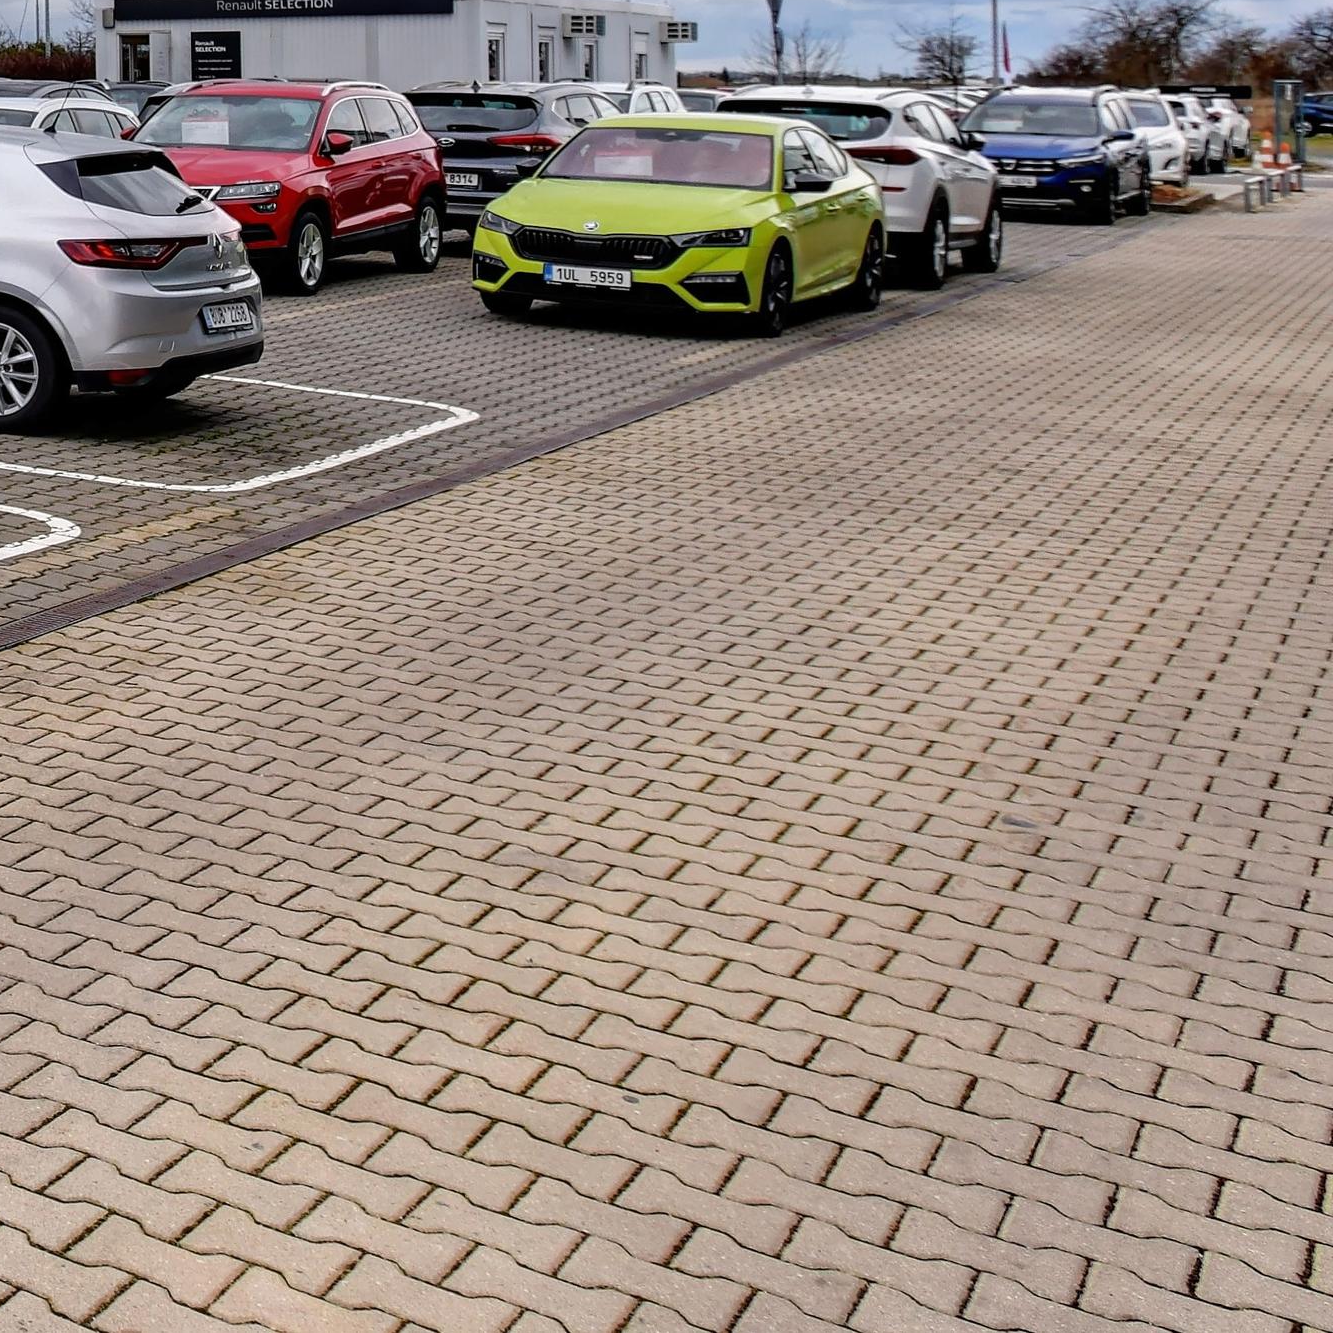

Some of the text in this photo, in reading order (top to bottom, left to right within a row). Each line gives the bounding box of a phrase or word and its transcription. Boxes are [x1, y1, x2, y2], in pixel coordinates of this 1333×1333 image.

[216, 0, 263, 11] Renault
[556, 268, 624, 285] 1UL 5959
